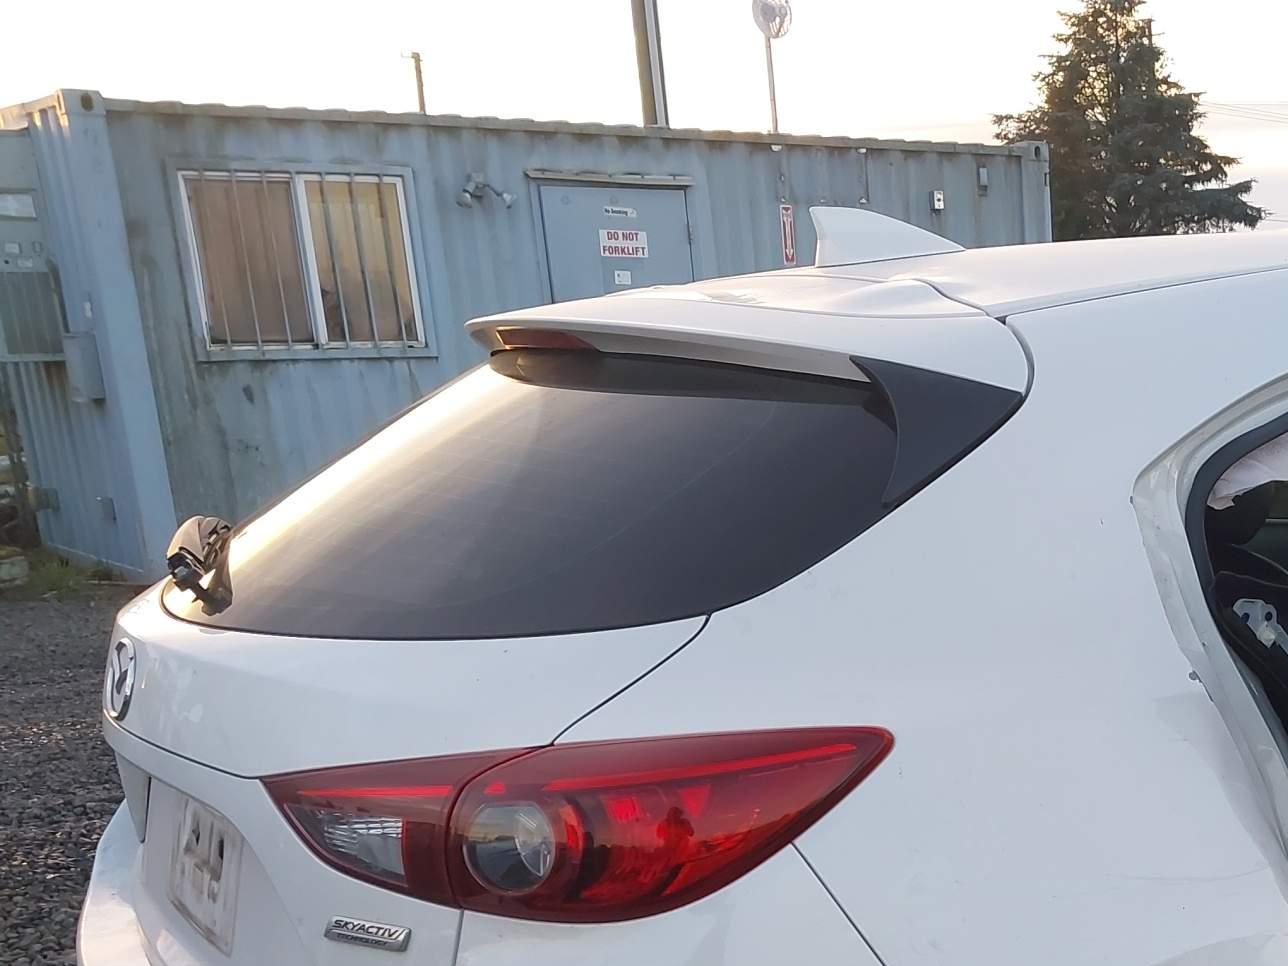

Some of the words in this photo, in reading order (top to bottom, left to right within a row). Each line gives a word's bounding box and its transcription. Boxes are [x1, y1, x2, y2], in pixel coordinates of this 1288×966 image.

[607, 231, 619, 241] DO
[622, 232, 639, 242] NOT
[602, 246, 646, 256] FORKLIFT
[332, 919, 398, 938] SKYACTIV
